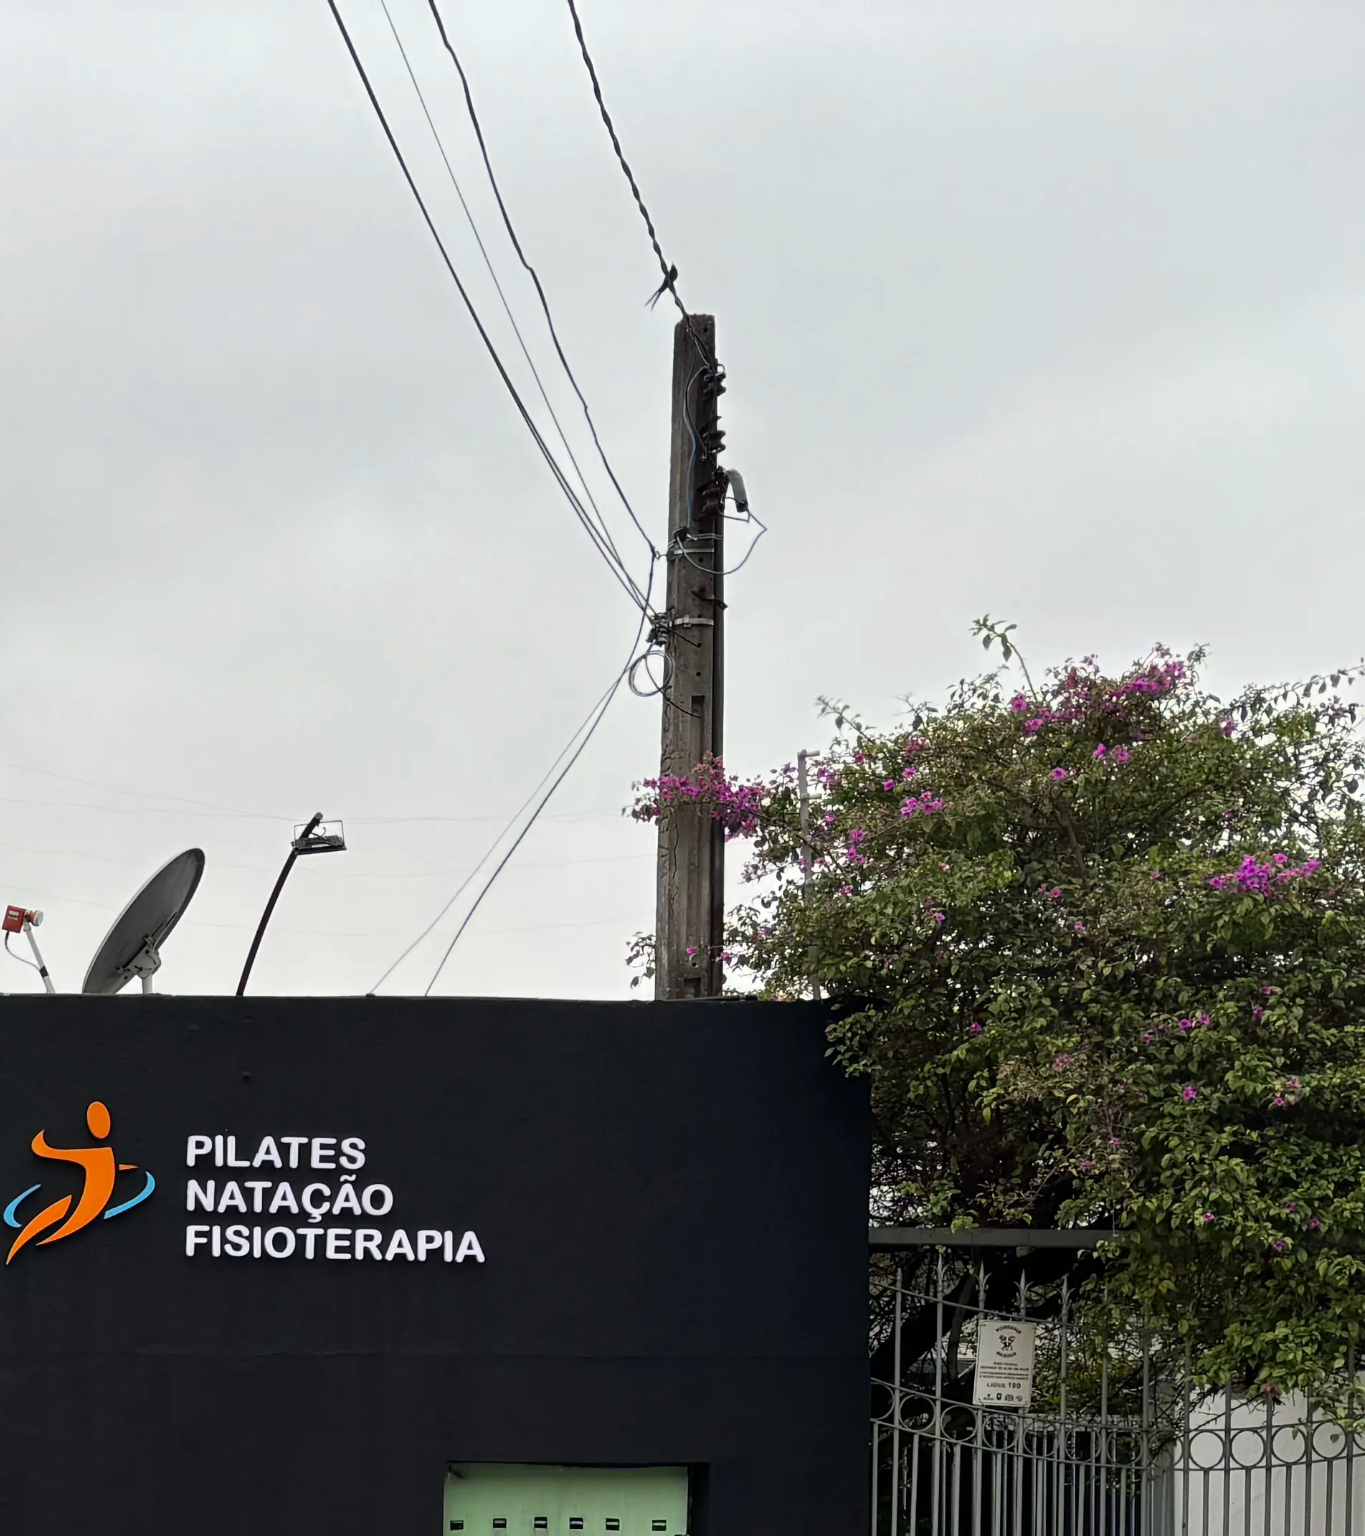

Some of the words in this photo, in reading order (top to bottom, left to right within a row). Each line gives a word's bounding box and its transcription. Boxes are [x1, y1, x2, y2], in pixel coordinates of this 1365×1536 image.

[186, 1135, 366, 1170] PILATES
[186, 1174, 394, 1223] NATAÇÃO
[185, 1225, 486, 1263] FISIOTERAPIA
